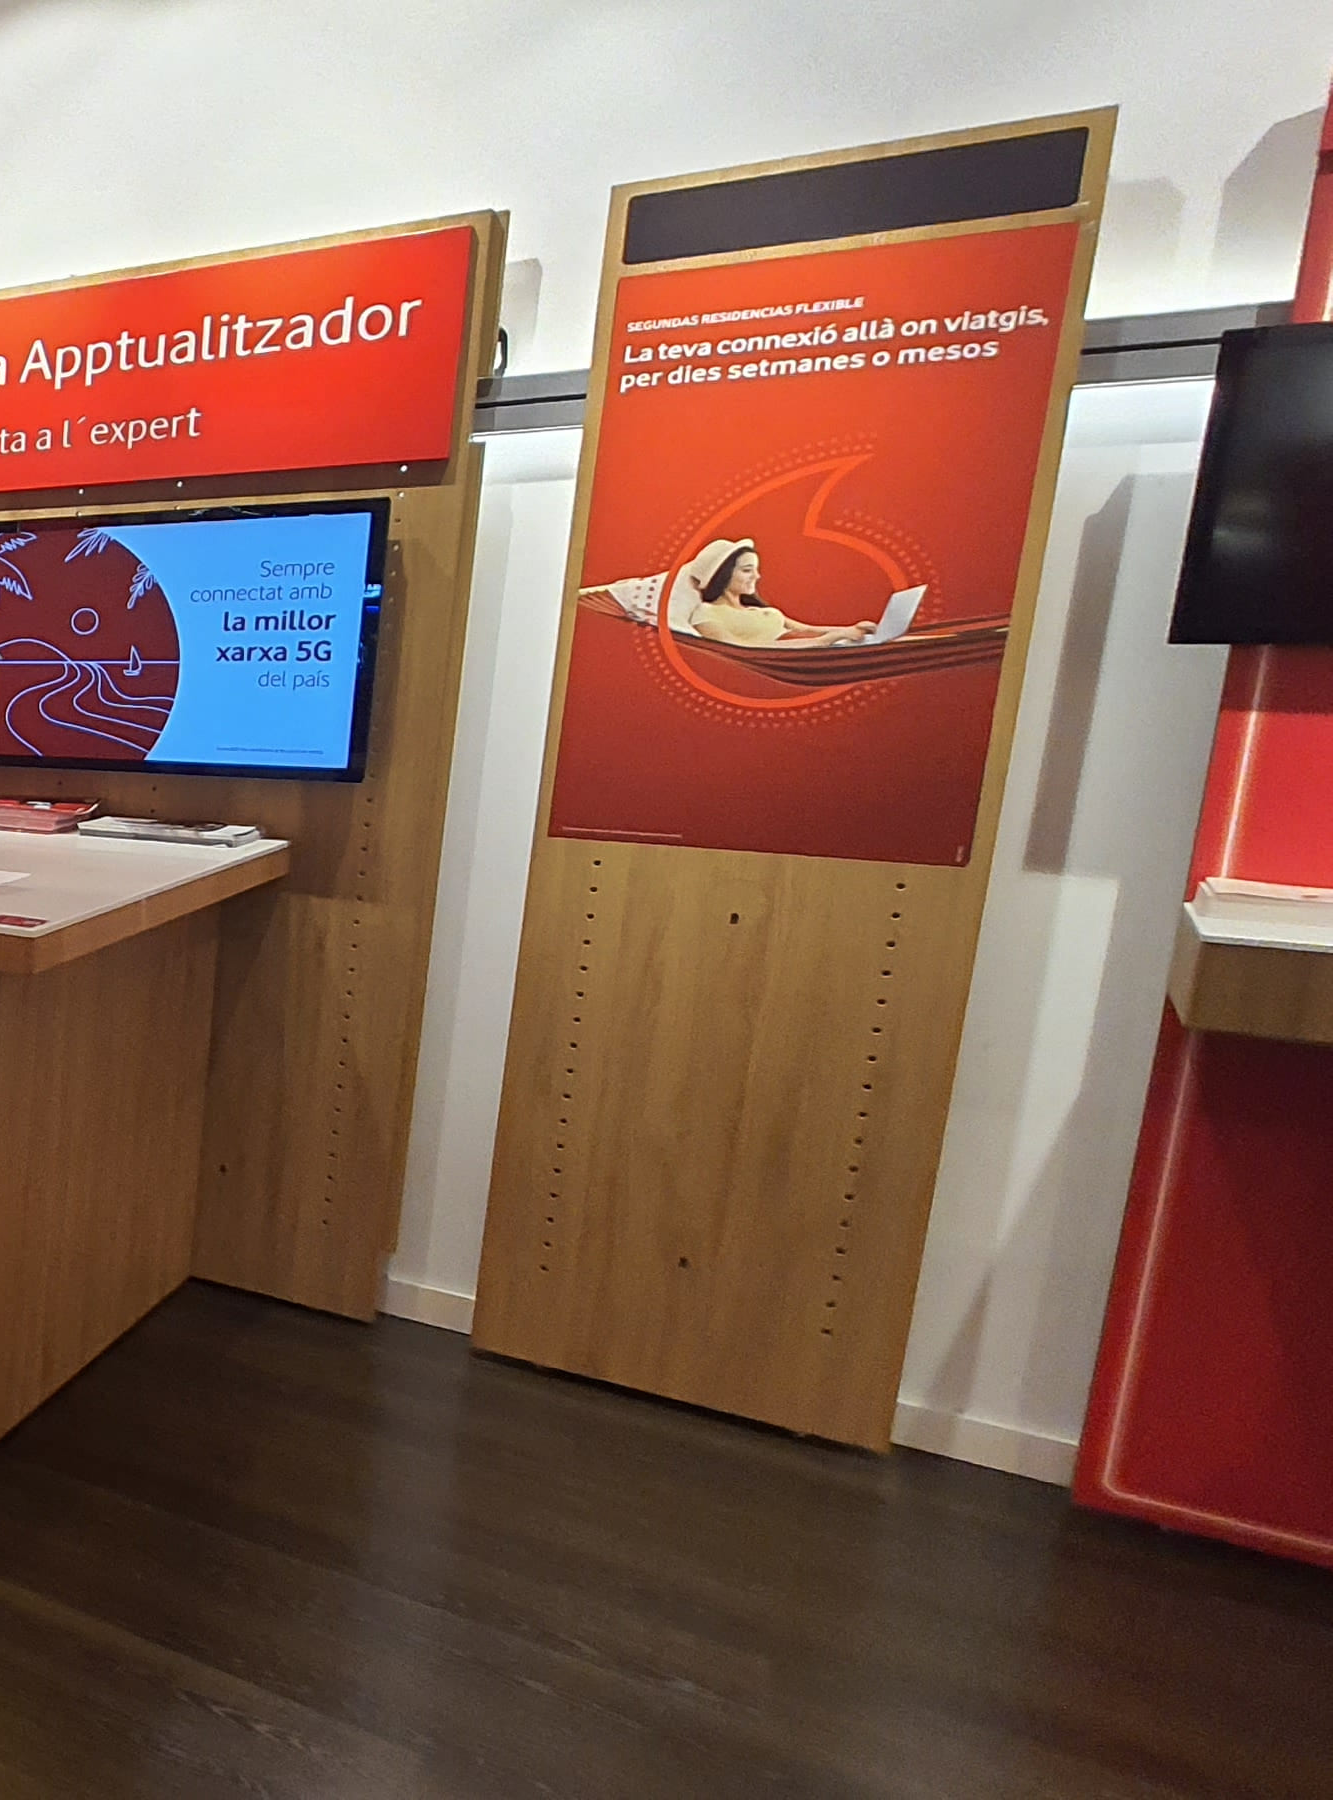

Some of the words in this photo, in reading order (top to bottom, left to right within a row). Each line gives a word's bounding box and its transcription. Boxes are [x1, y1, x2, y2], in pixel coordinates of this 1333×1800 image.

[627, 315, 699, 333] SEGUNDAS
[700, 305, 794, 325] RESIDENCIAS
[795, 296, 865, 315] FLEXIBLE
[19, 295, 423, 391] Apptualitzador
[624, 344, 653, 364] La
[658, 340, 711, 360] teva
[716, 322, 838, 356] connexió
[842, 317, 894, 344] allà
[900, 317, 937, 337] on
[943, 304, 1050, 335] viatgis,
[620, 363, 668, 393] per
[667, 362, 722, 385] dies
[728, 350, 866, 380] setmanes
[871, 350, 890, 367] o
[897, 340, 1000, 365] mesos
[36, 428, 52, 451] a
[260, 560, 336, 581] Sempre
[190, 585, 283, 603] connectat
[289, 582, 333, 600] amb
[223, 611, 247, 632] la
[254, 609, 337, 631] millor
[216, 646, 288, 662] xarxa
[295, 640, 333, 662] 5G
[258, 671, 287, 688] del
[292, 670, 331, 691] país
